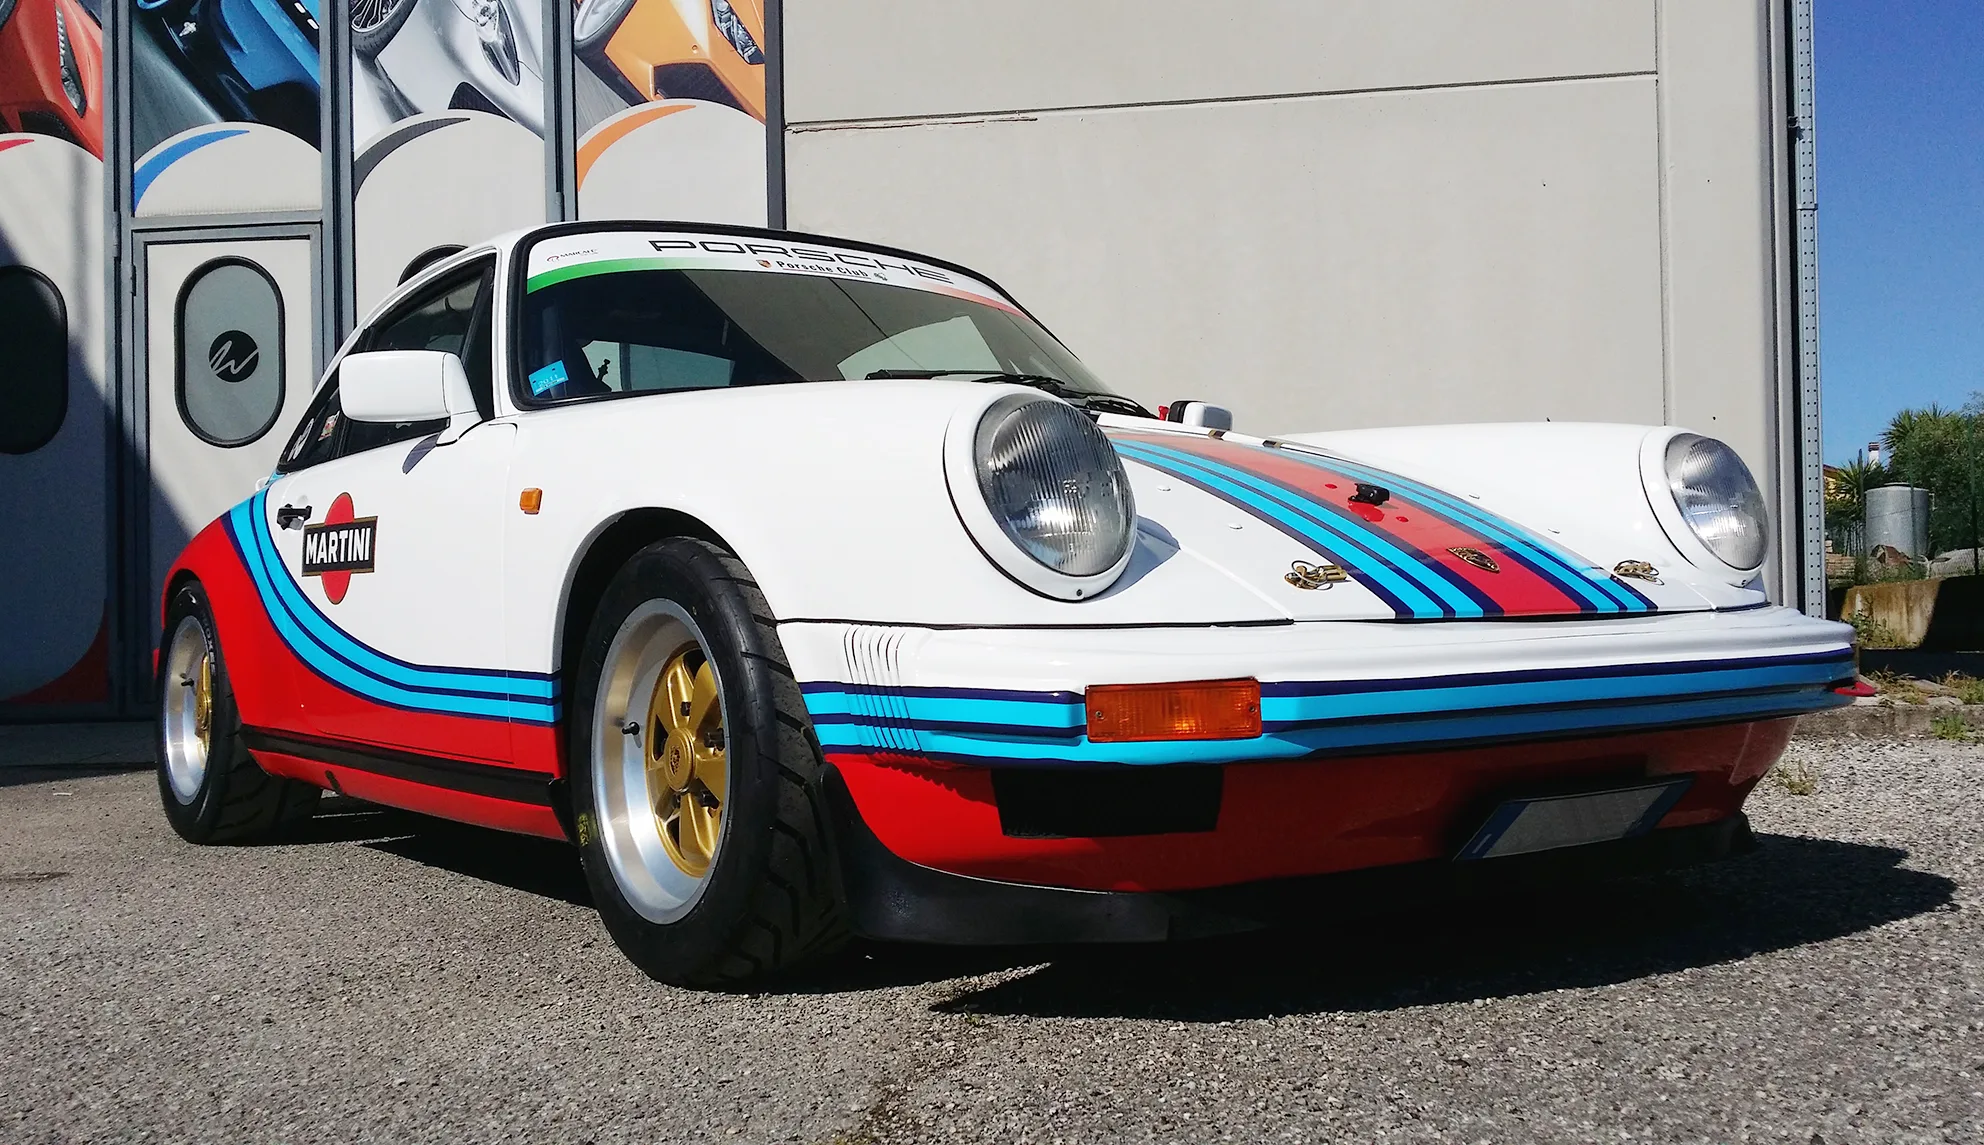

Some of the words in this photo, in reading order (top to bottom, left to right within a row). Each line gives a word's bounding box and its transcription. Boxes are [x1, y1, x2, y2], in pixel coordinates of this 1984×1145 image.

[648, 240, 954, 285] PORSCHE
[775, 260, 834, 273] Porsche
[836, 266, 869, 278] Club
[305, 527, 372, 565] MARTINI
